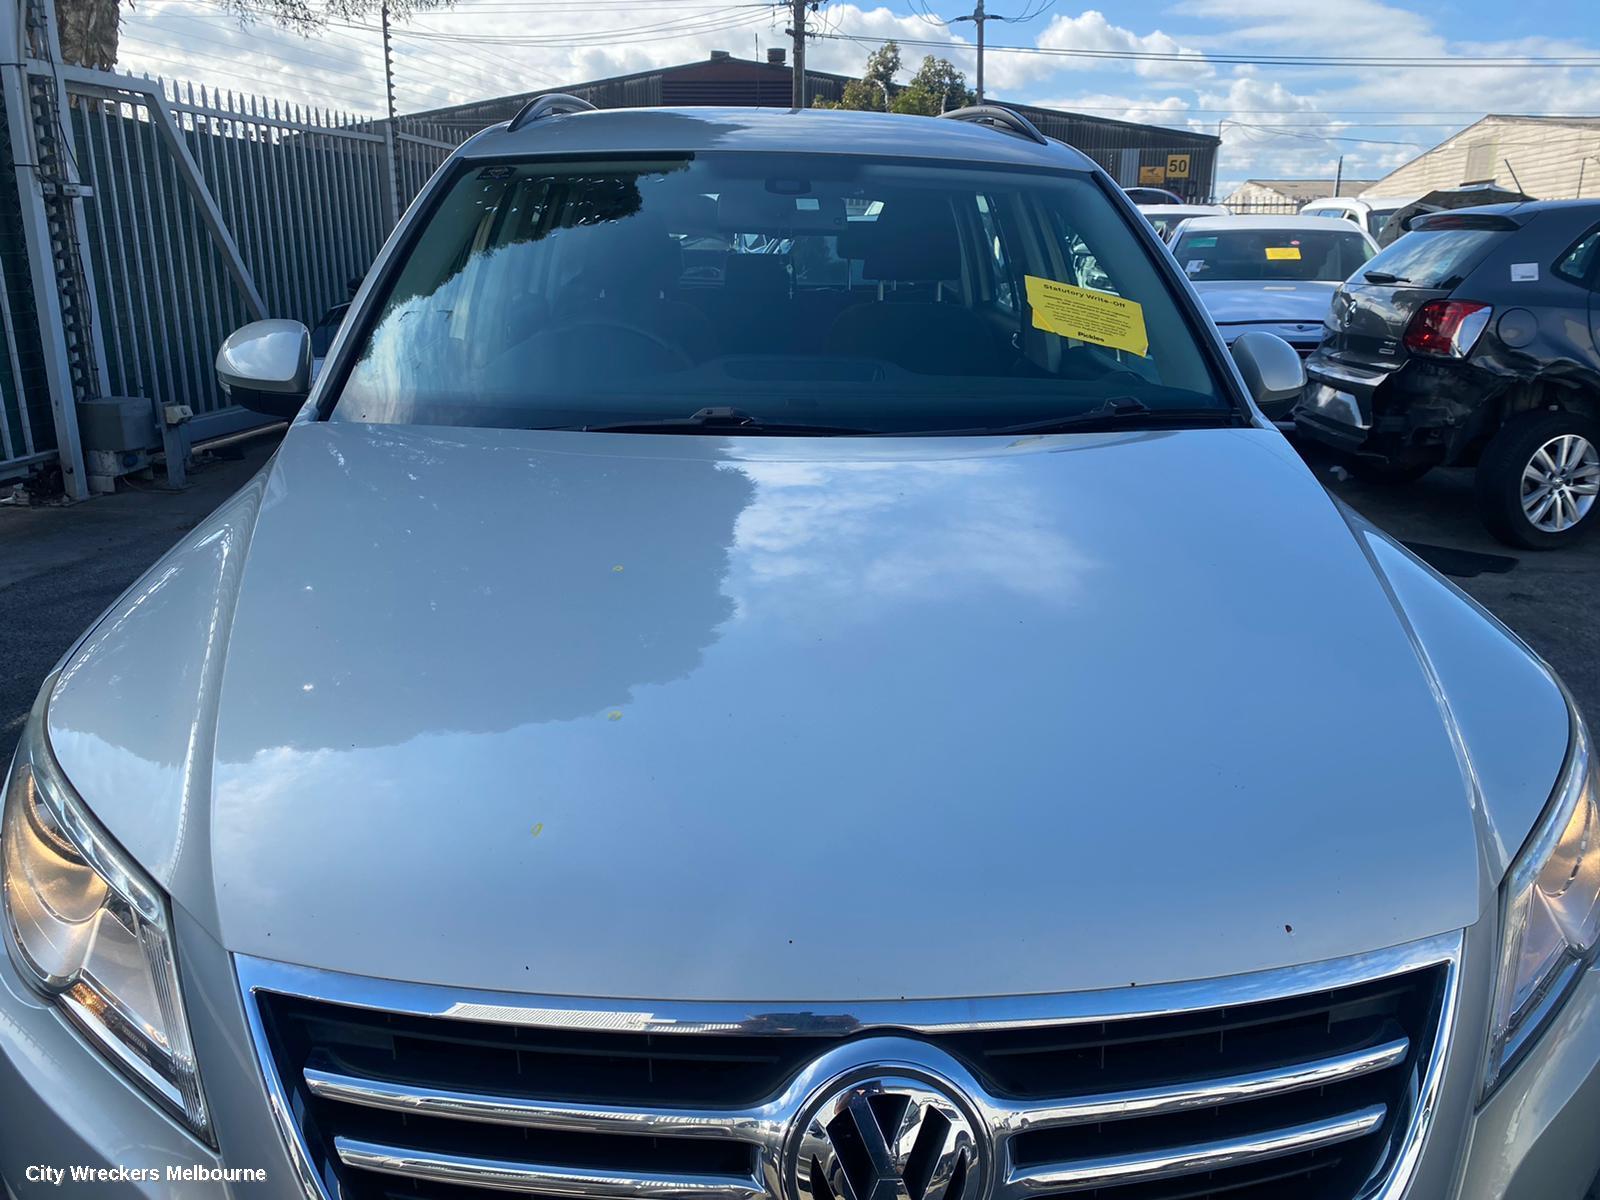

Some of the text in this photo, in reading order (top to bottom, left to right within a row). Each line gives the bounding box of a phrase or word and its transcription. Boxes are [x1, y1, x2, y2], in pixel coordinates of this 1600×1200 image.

[1169, 160, 1187, 172] 50
[1043, 284, 1126, 308] Statutory Write-Off
[1077, 331, 1105, 342] Pickles
